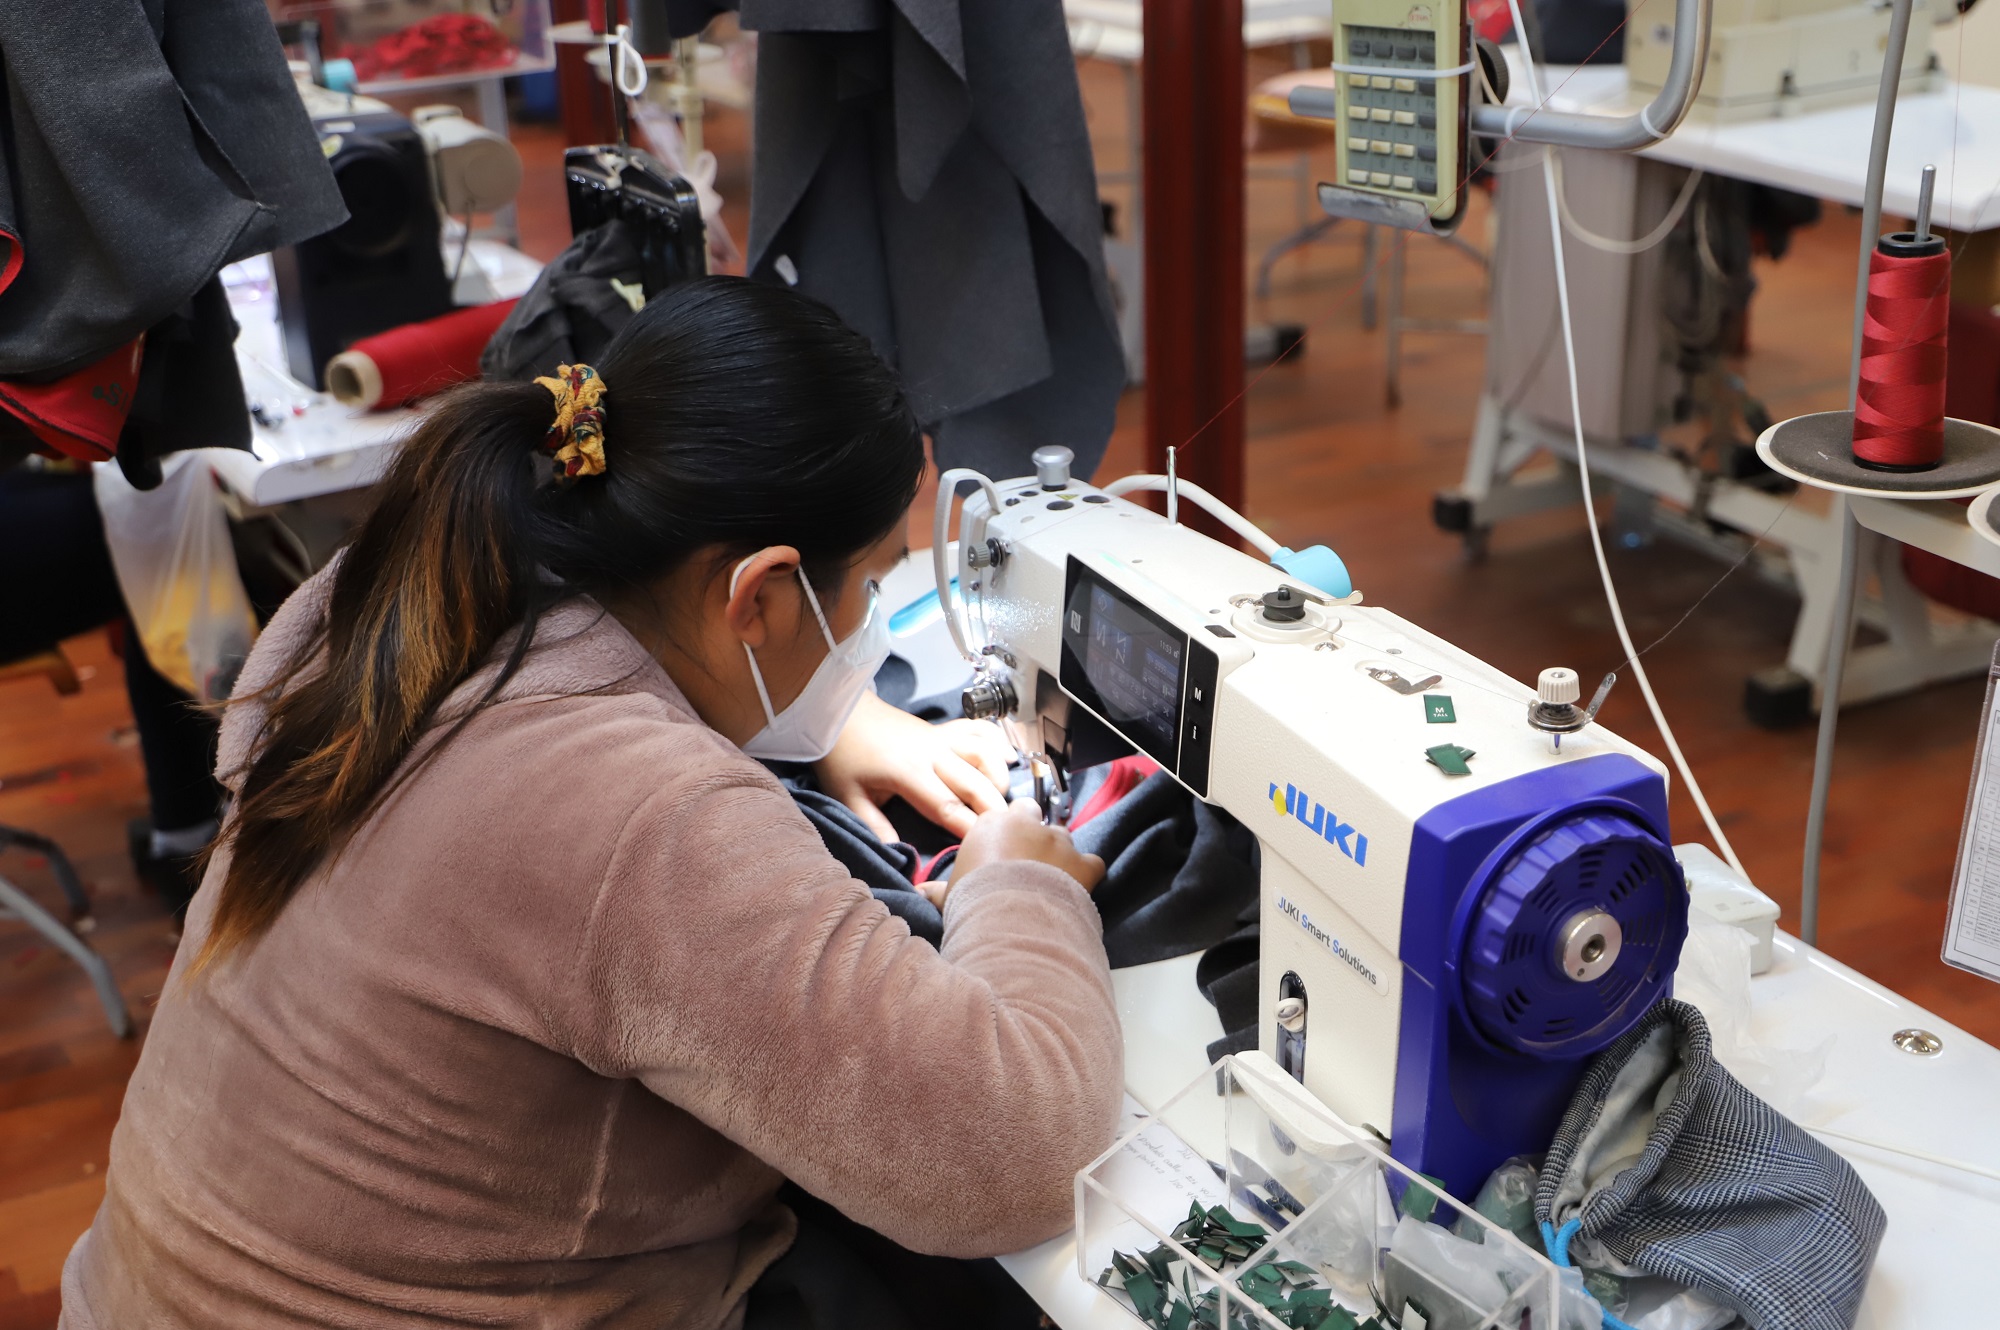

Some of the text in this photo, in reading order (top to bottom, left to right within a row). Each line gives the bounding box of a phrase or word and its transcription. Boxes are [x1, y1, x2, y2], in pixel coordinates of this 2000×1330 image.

[1194, 687, 1202, 701] M
[1435, 706, 1445, 714] M
[1268, 782, 1368, 868] JUKI
[1277, 896, 1377, 985] JUKI Smart Solutions
